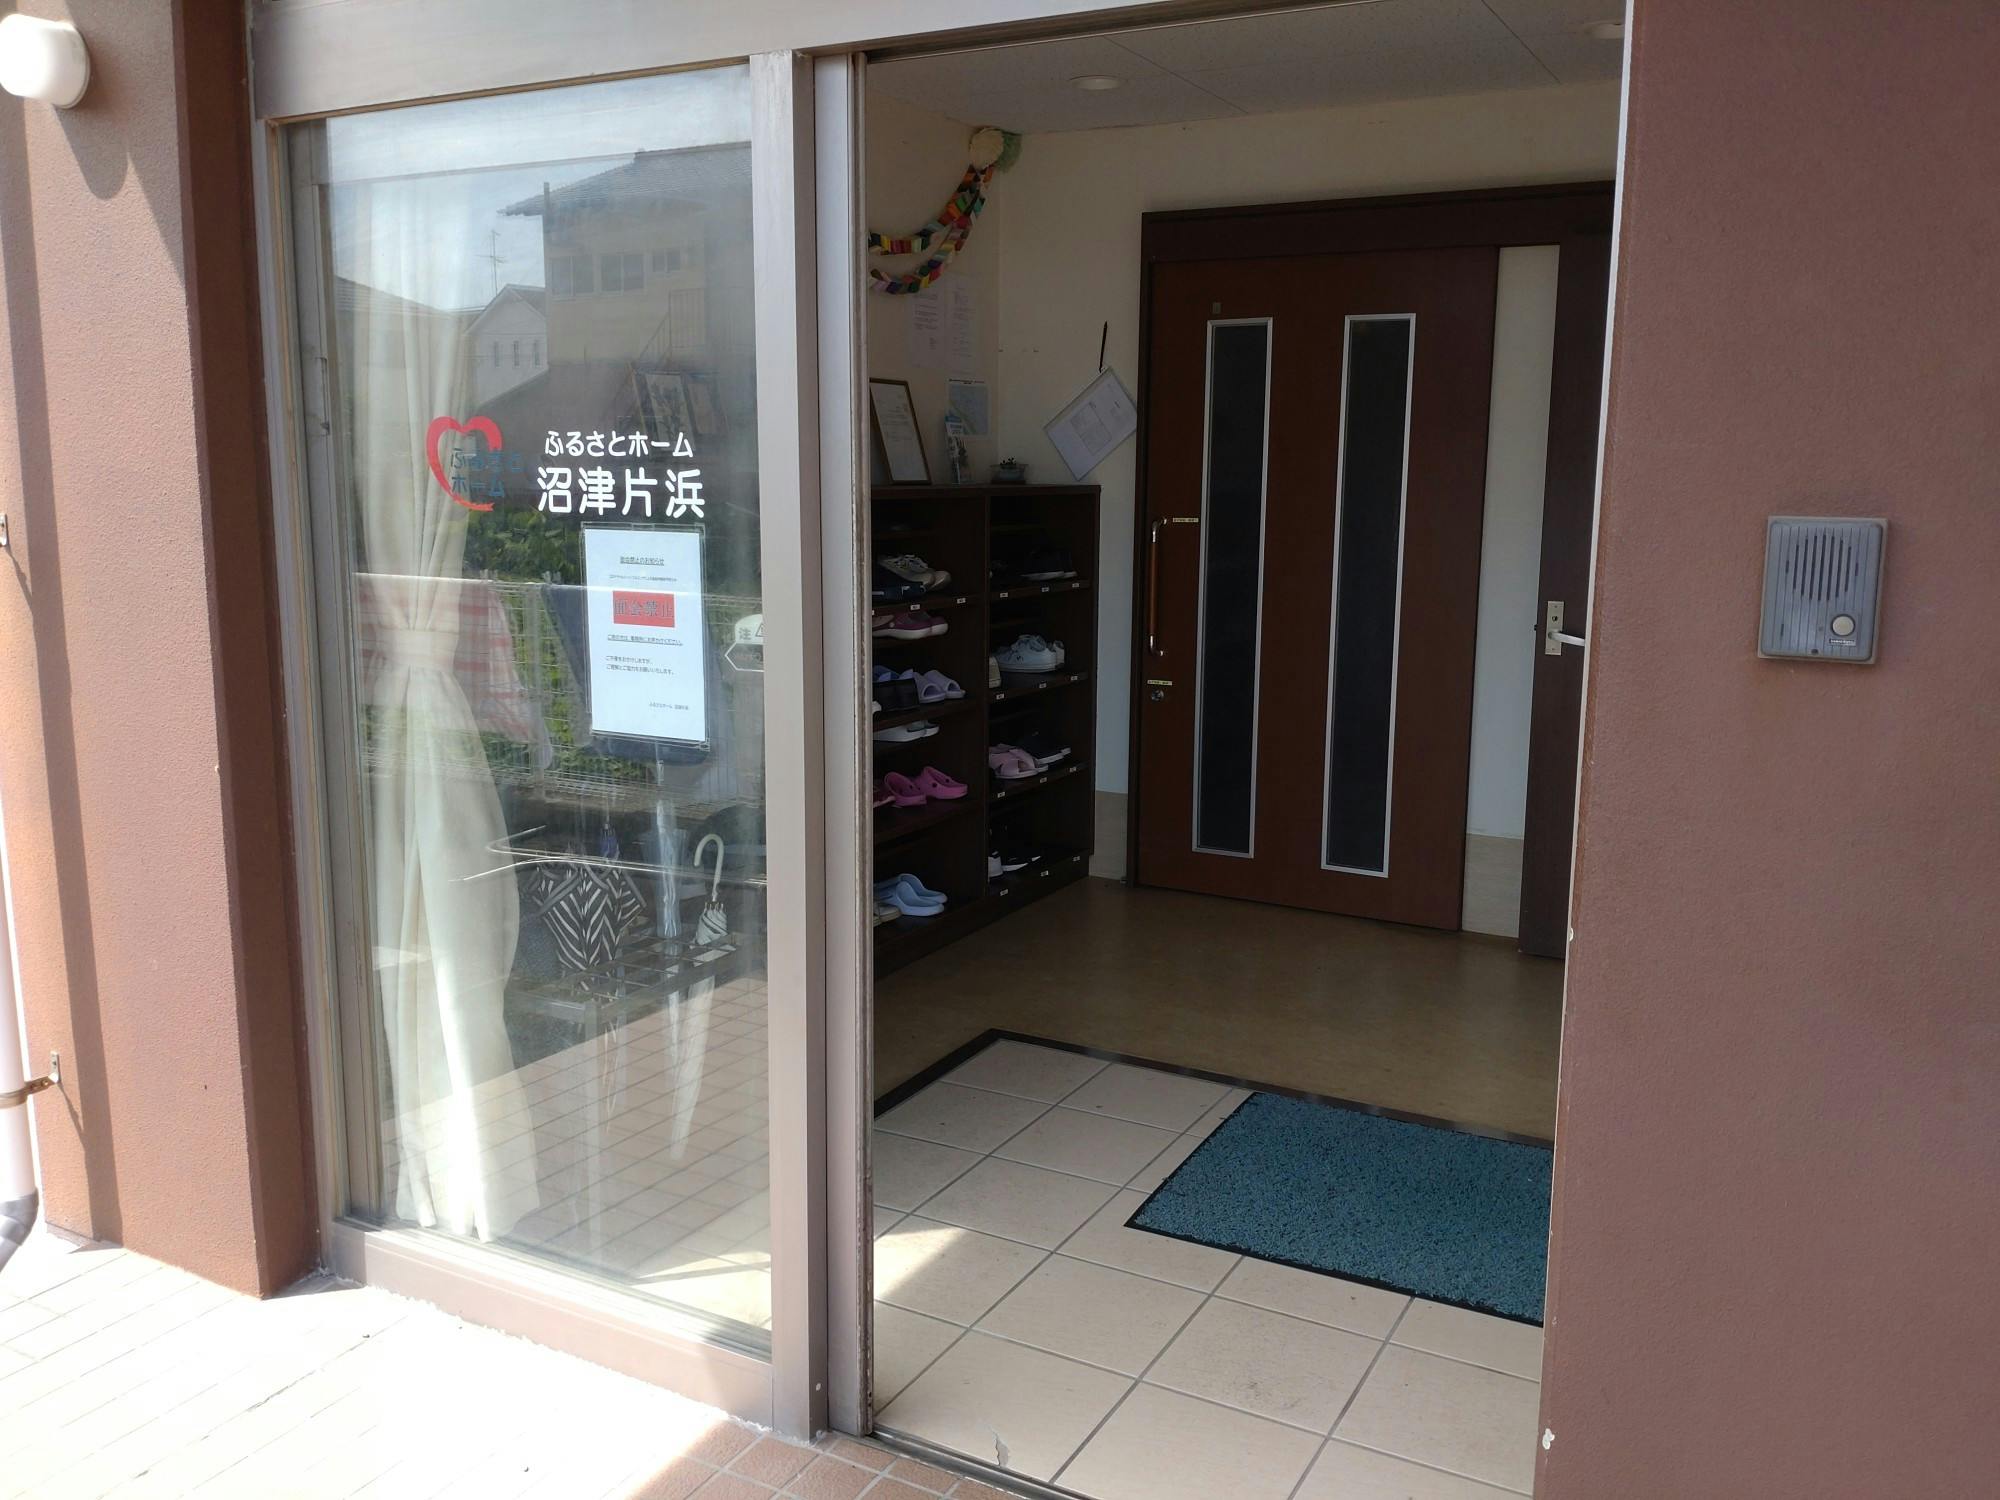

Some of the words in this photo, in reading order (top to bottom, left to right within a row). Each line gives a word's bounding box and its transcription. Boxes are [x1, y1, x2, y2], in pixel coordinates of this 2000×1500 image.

[545, 430, 695, 458] ふるさとホーム
[451, 476, 505, 498] ホーム
[537, 466, 706, 518] 沼津片浜
[738, 627, 752, 641] 注
